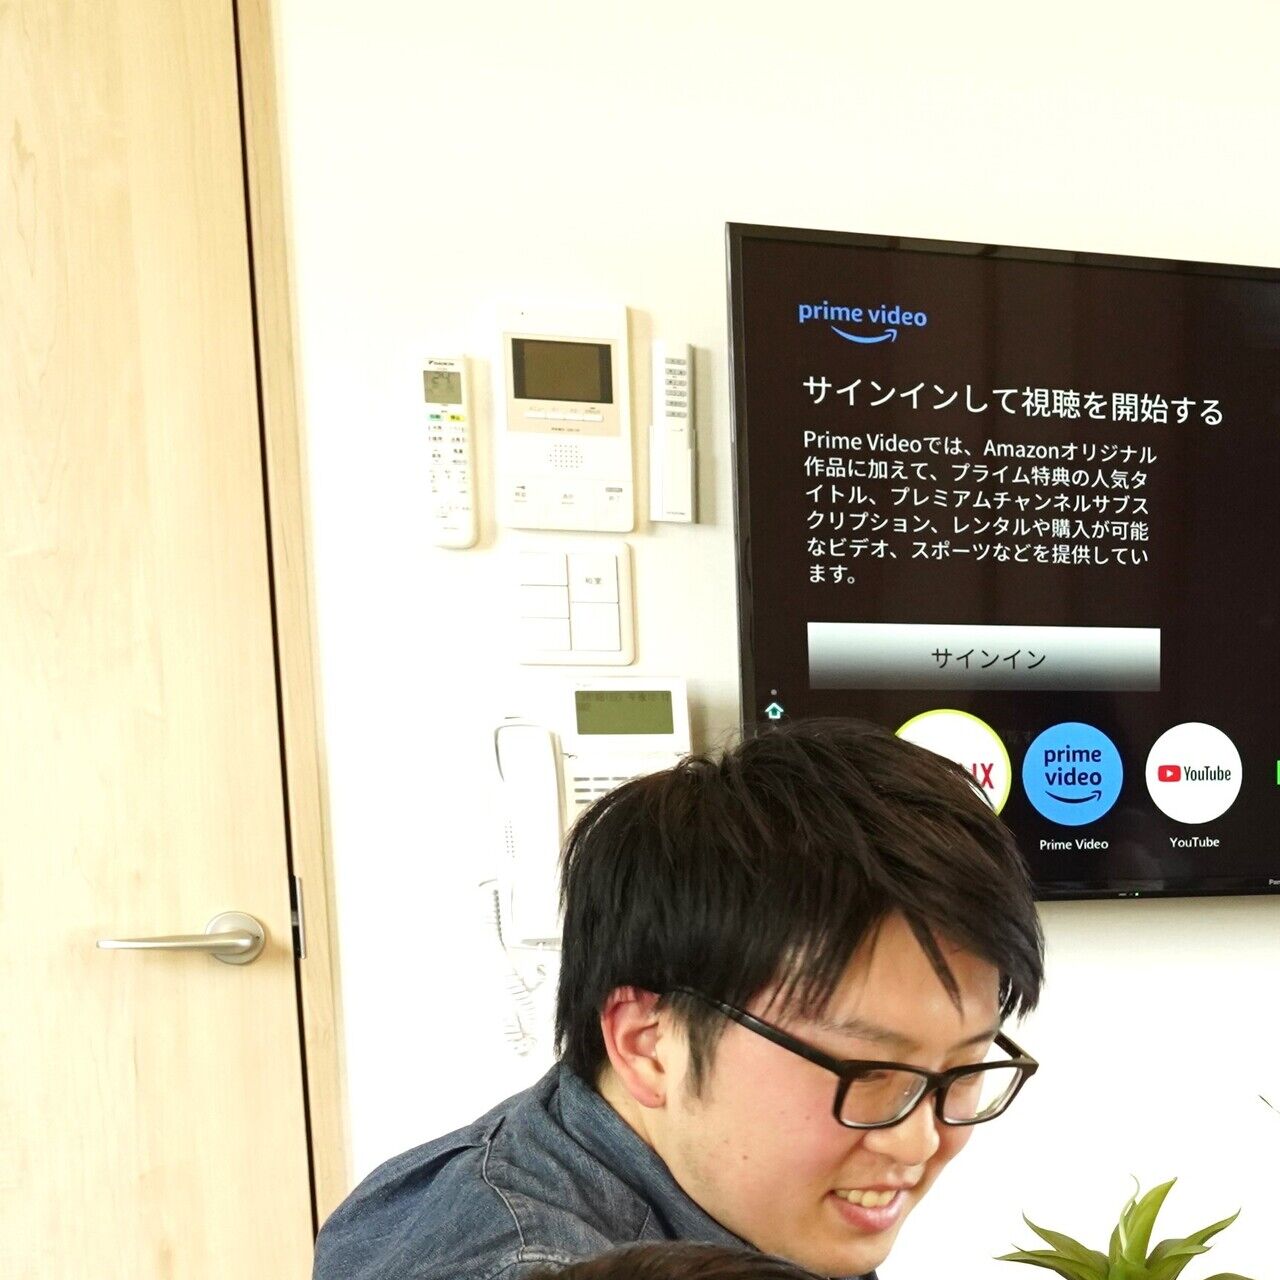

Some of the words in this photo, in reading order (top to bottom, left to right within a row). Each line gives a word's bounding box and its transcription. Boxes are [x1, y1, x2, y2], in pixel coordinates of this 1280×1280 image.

[799, 300, 864, 324] prime
[868, 304, 928, 327] video
[803, 376, 1223, 426] サインインして視聴を開始する
[804, 431, 862, 452] Prime
[867, 433, 1158, 465] Videoでは、Amazonオリジナル
[804, 457, 1148, 490] 作品に加えて、プライム特典の人気タ
[805, 485, 1150, 515] イトル、プレミアムチャンネルサブス
[806, 511, 1150, 542] クリプション、レンタルや購入が可能
[807, 537, 1149, 566] なビデオ、スポーツなどを提供してい
[808, 564, 857, 585] ます。
[931, 648, 1047, 671] サインイン
[1044, 744, 1102, 767] prime
[1045, 767, 1103, 787] video
[1184, 765, 1232, 783] YouTube
[1039, 839, 1073, 851] Prime
[1075, 838, 1109, 851] Video
[1169, 836, 1220, 849] YouTube
